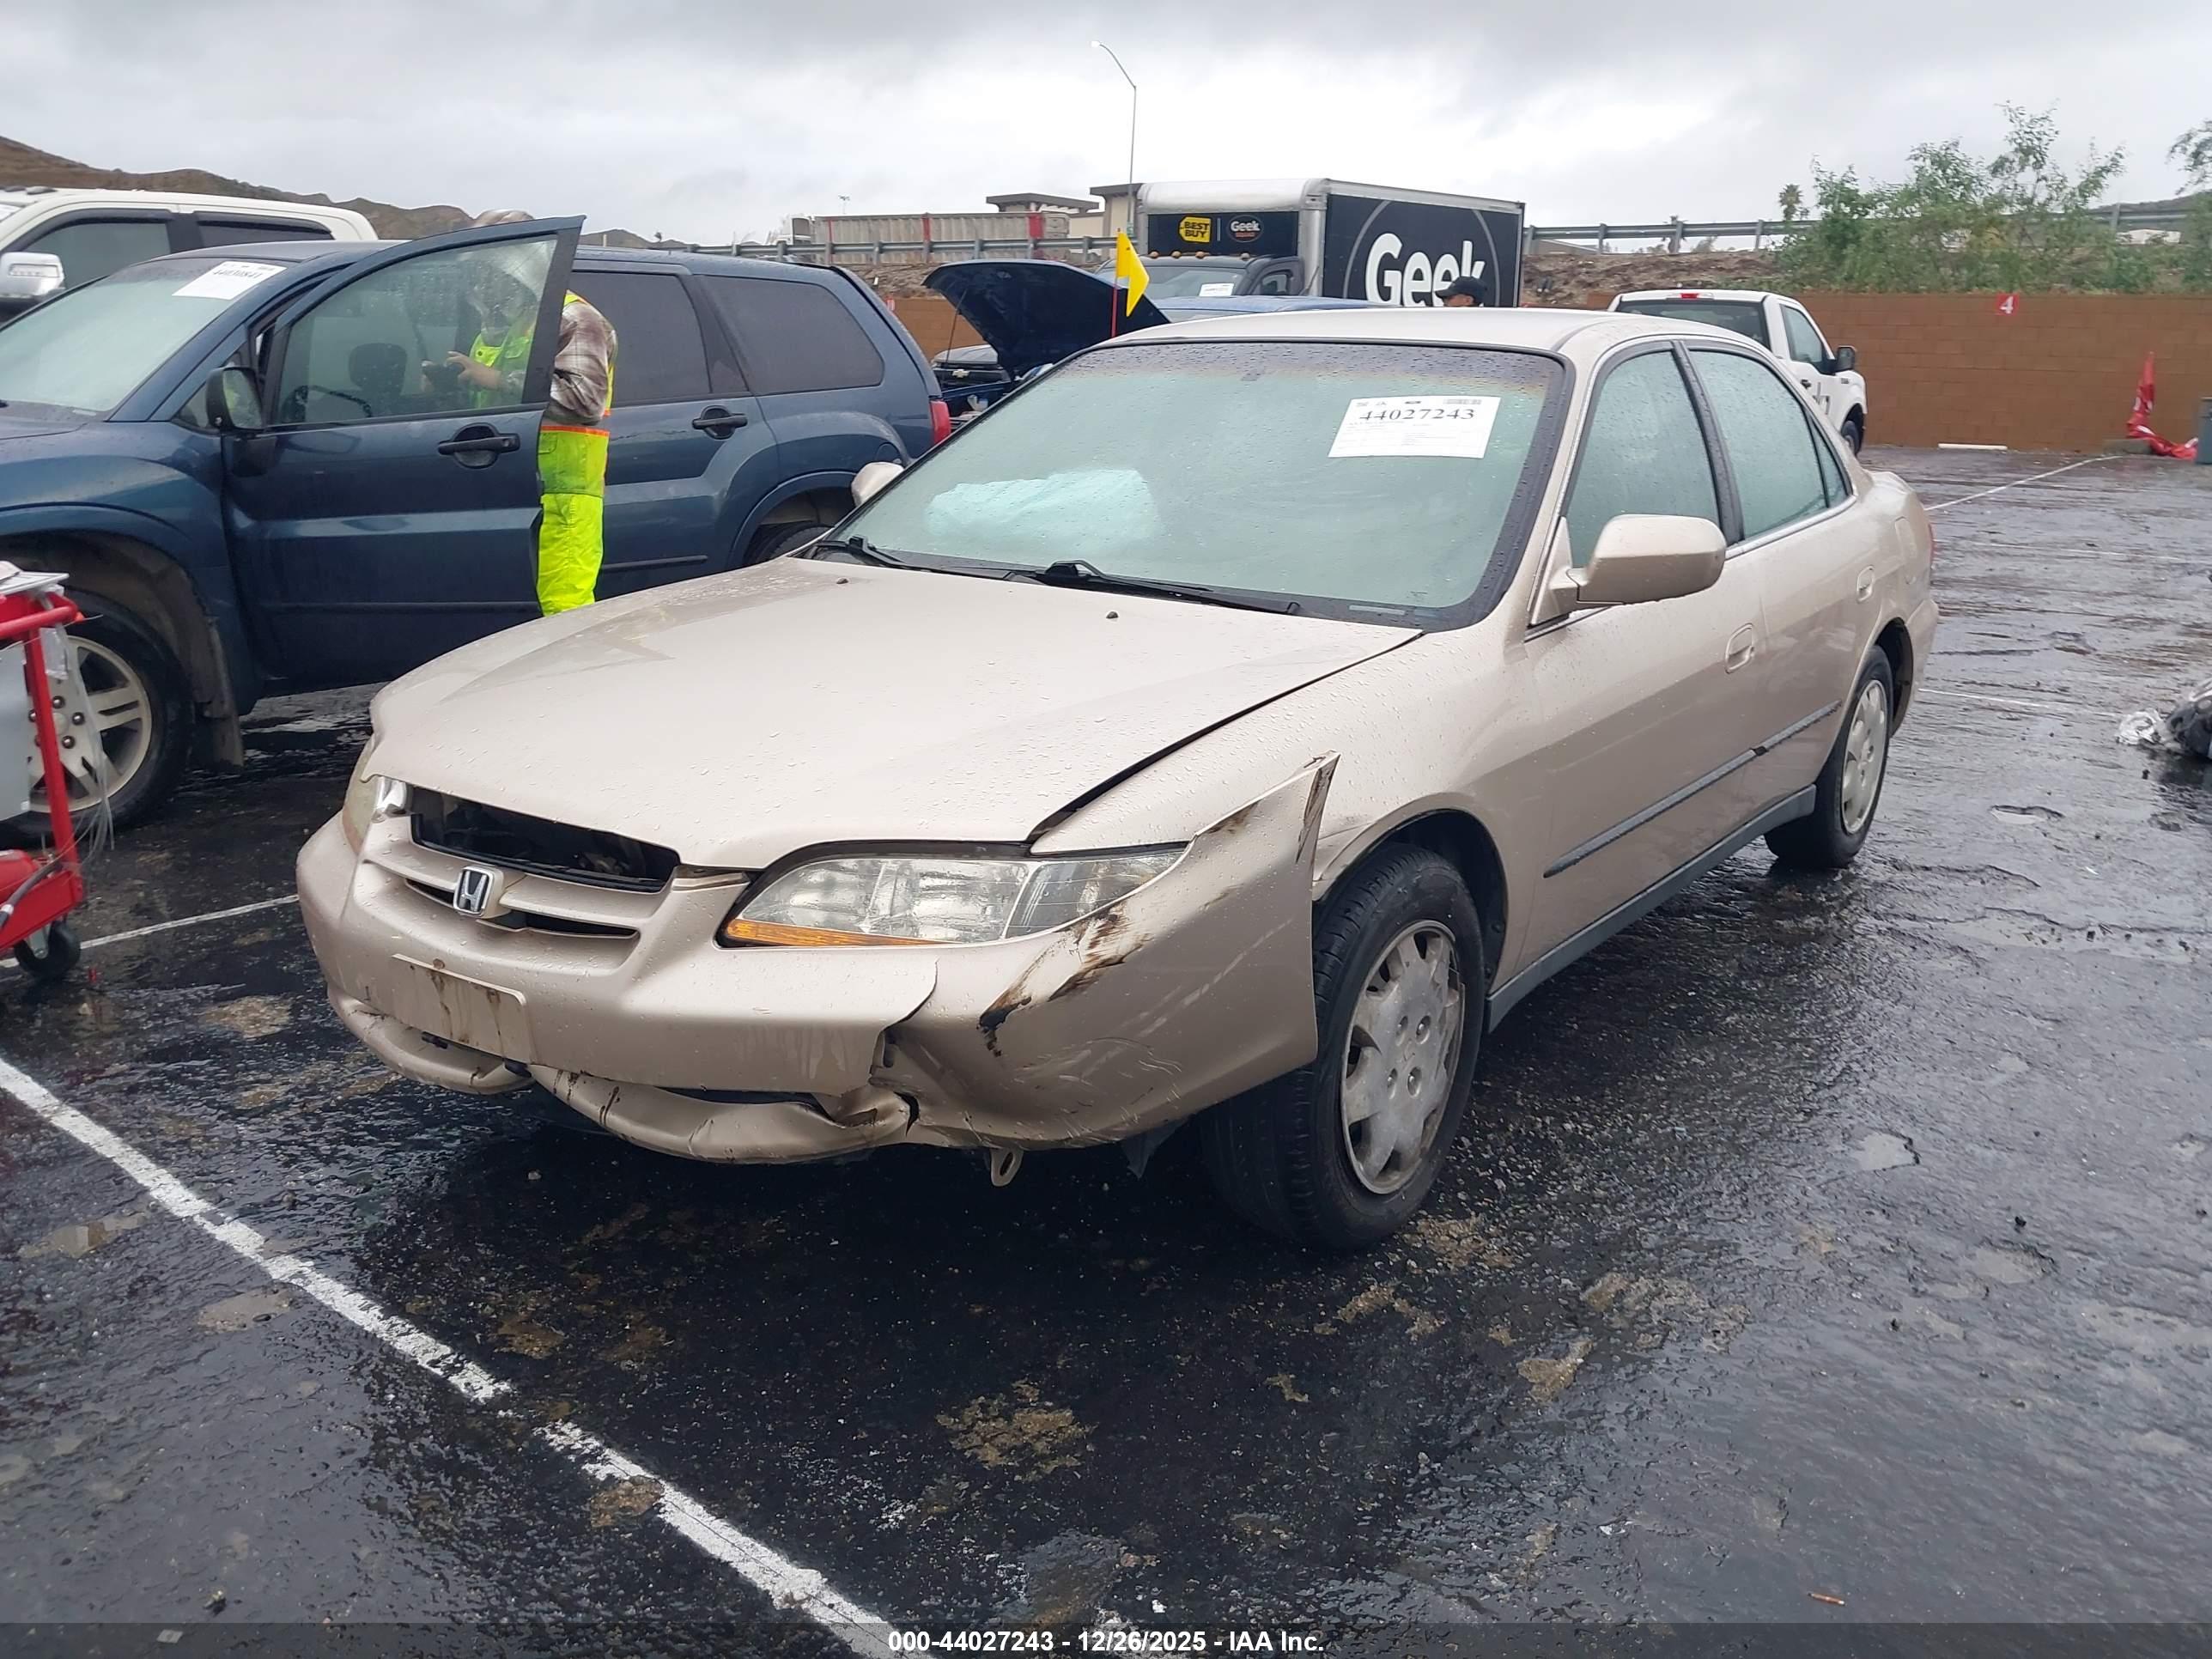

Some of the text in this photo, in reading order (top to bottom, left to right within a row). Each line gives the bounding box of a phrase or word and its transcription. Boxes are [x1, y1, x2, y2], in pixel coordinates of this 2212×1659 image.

[1184, 221, 1210, 231] BEST
[1231, 220, 1261, 232] Geek
[2000, 295, 2014, 314] 4
[1359, 409, 1475, 421] 44027243
